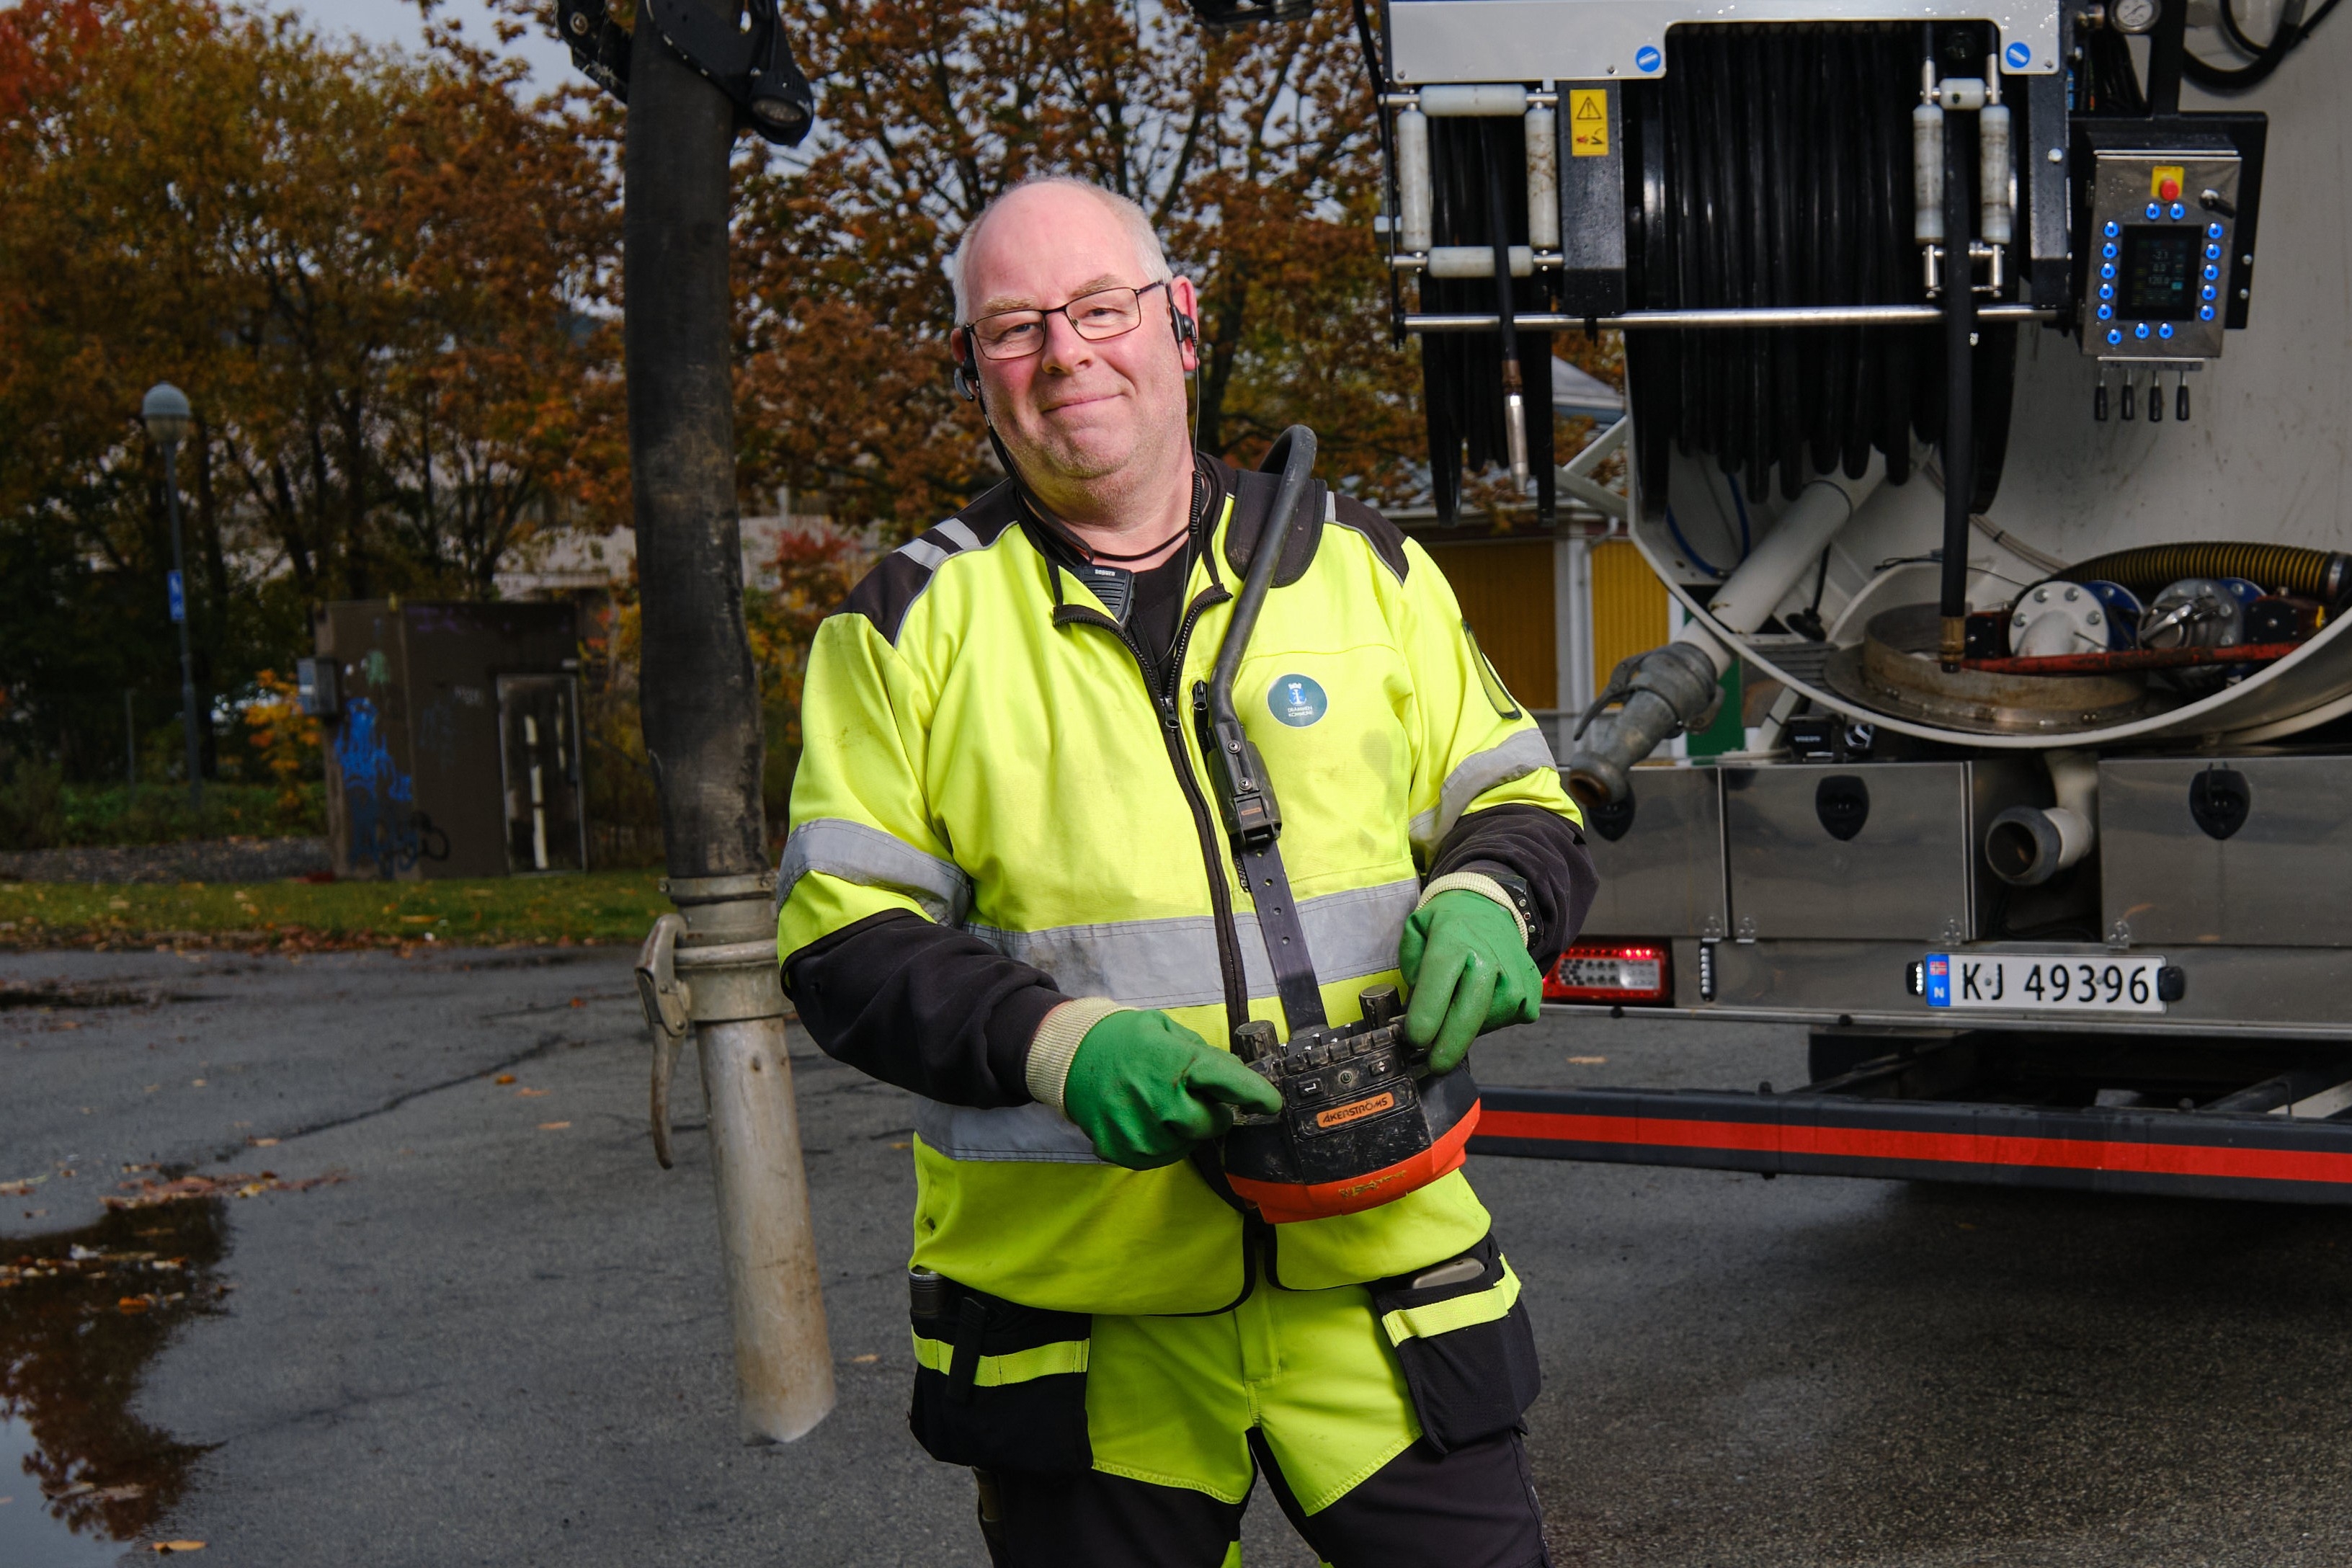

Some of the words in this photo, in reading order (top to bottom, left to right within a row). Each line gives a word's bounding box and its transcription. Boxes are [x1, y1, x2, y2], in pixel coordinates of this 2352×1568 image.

[1933, 986, 1945, 999] N
[1962, 963, 2004, 1001] KJ
[2023, 964, 2150, 1004] 49396
